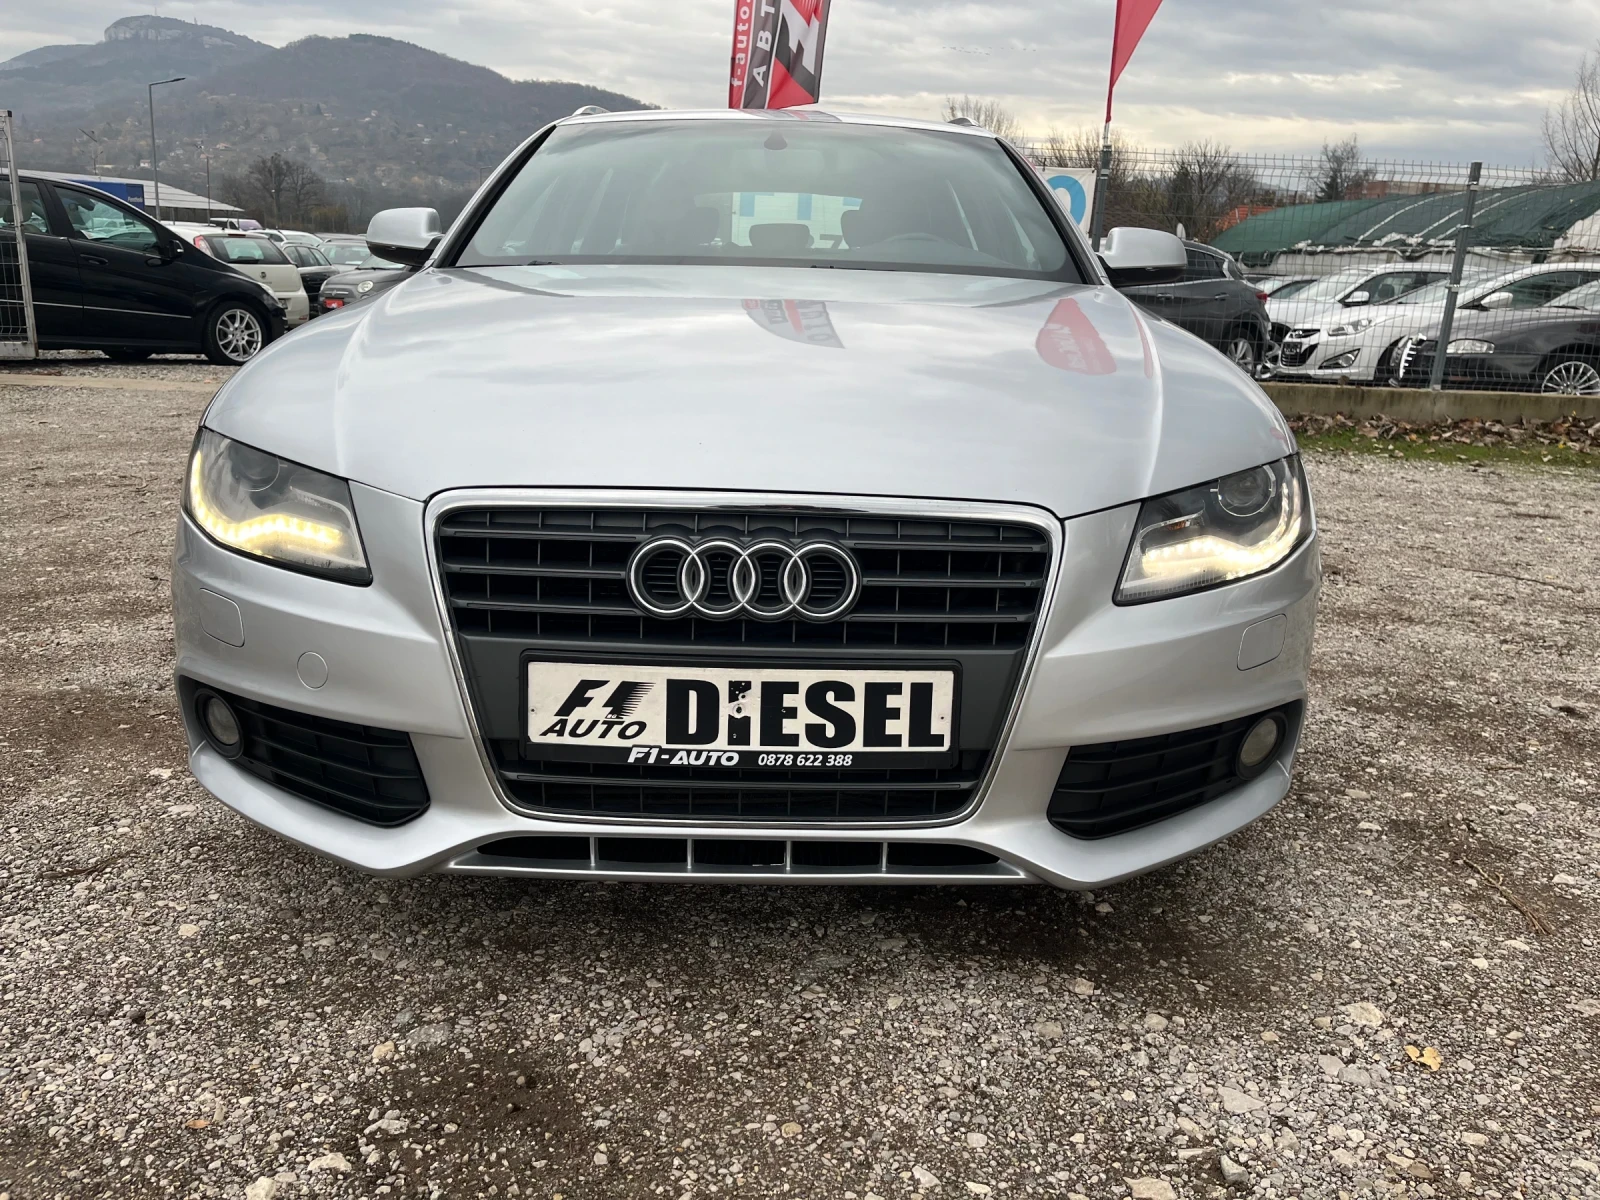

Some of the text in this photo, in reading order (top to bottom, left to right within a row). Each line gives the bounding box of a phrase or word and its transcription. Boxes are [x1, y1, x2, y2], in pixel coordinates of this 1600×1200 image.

[665, 678, 945, 749] DIESEL
[539, 718, 647, 740] AUTO
[627, 747, 853, 767] F1-AUTO 0878 622 388
